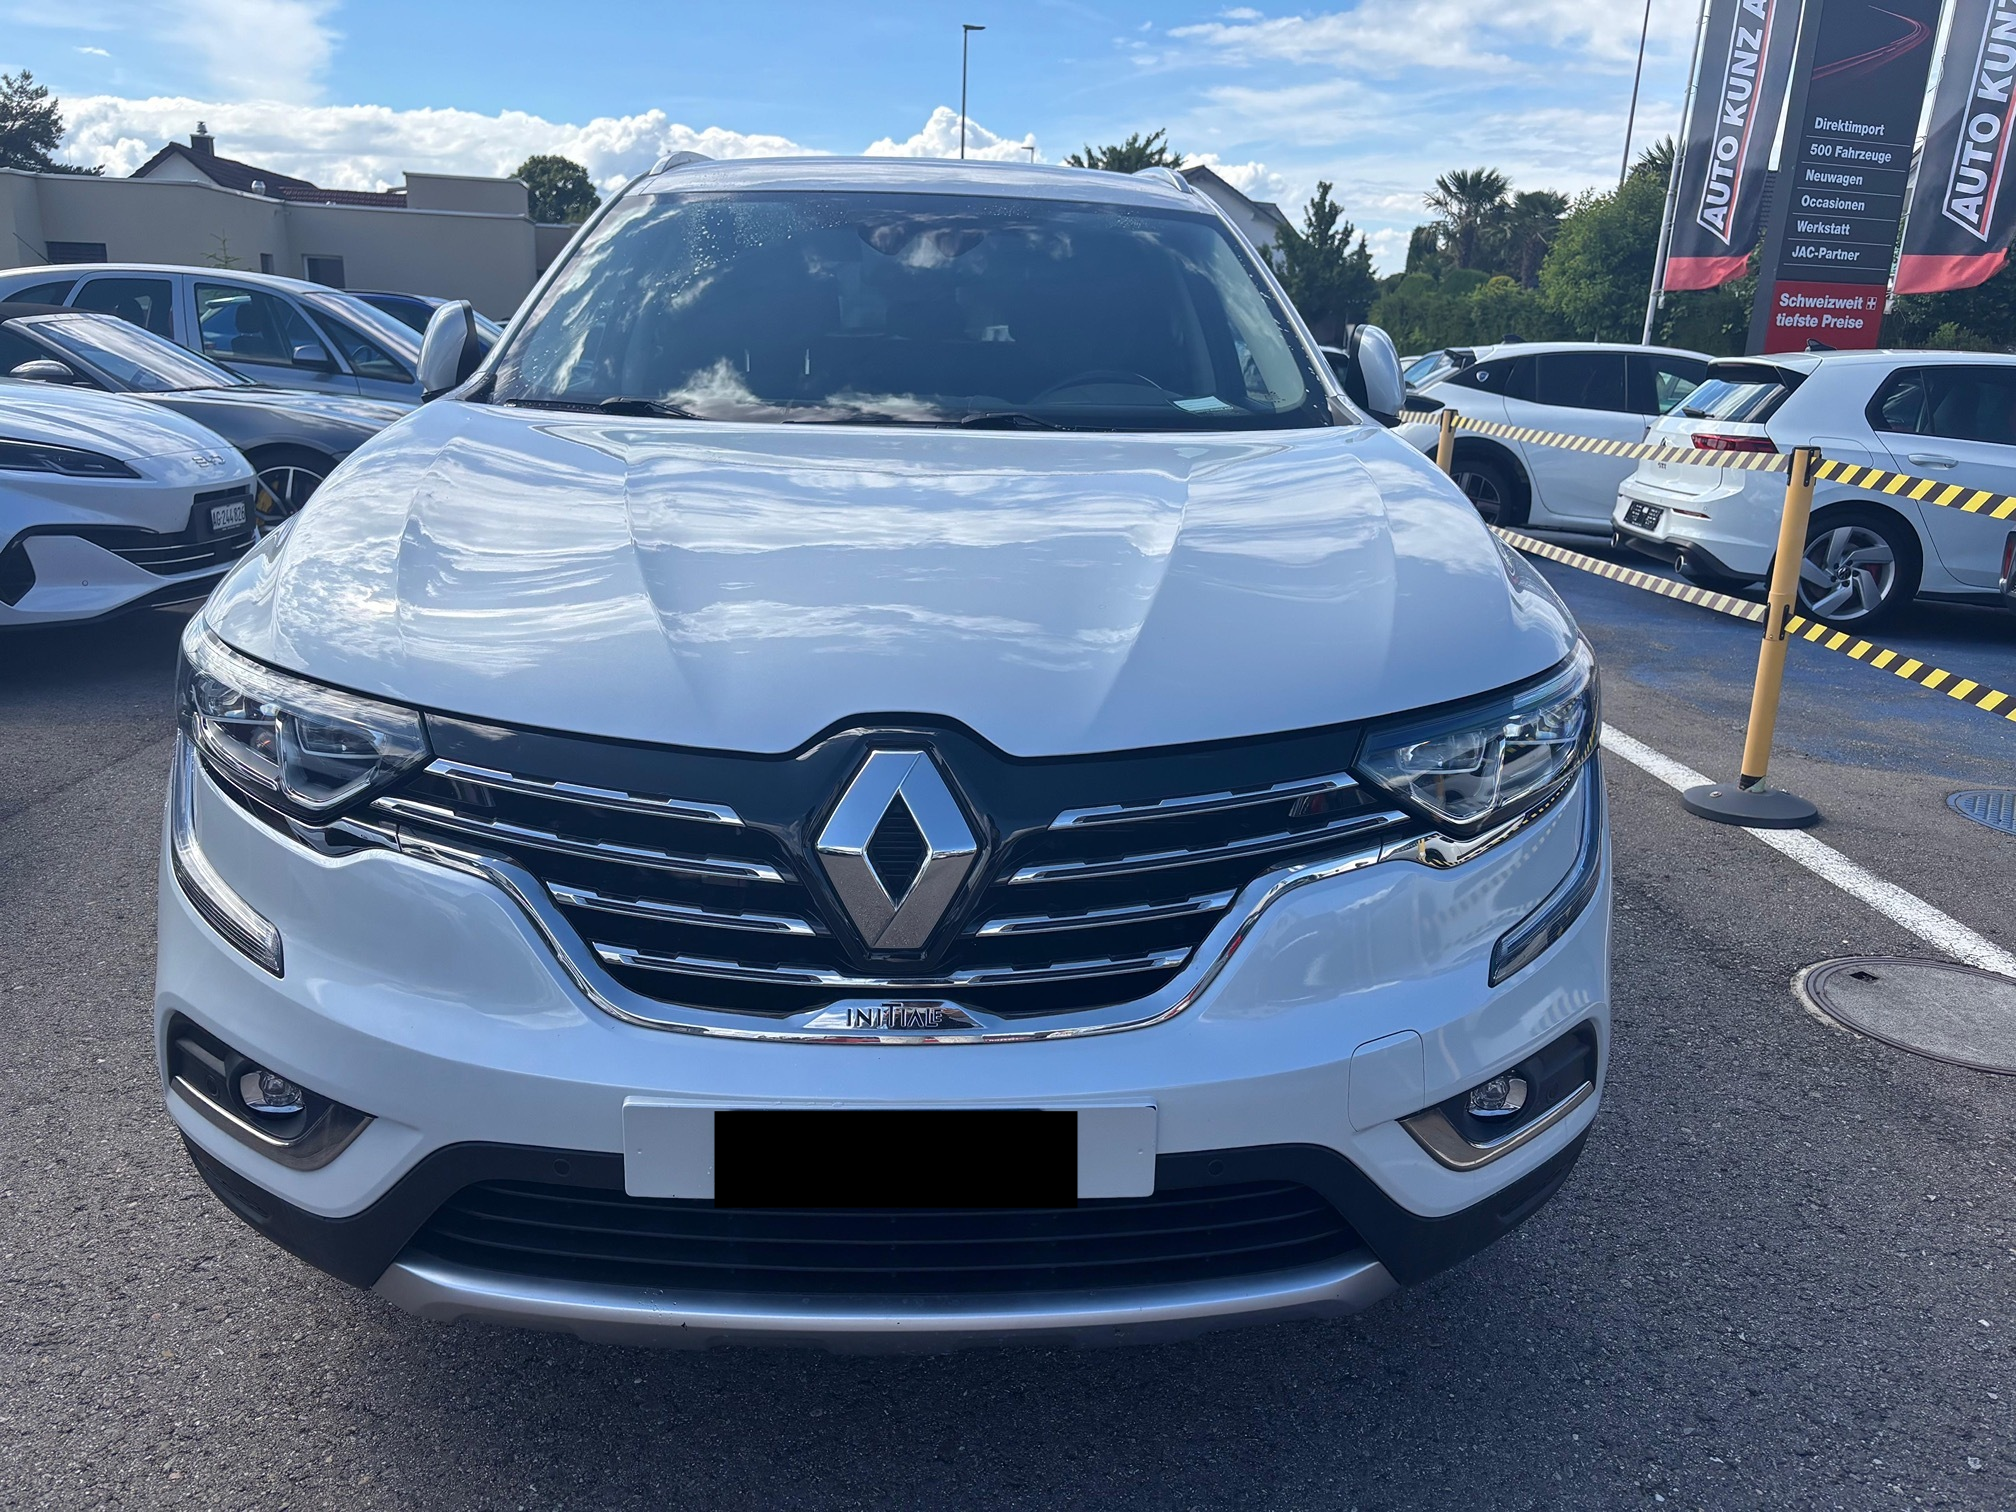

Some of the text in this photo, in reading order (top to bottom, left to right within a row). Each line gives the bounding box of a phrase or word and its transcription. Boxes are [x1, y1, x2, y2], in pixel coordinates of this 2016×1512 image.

[1950, 0, 2016, 225] AUTO KUN
[1703, 135, 1739, 231] AUTO
[1722, 26, 1763, 127] KUNZ
[1814, 116, 1885, 137] Direktimport
[1809, 143, 1892, 164] 500 Fahrzeuge
[1805, 168, 1863, 187] Neuwagen
[1801, 194, 1865, 211] Occasionen
[1797, 220, 1851, 235] Werkstatt
[1791, 245, 1860, 261] JAC-Partner
[1779, 292, 1864, 310] Schweizweit
[1776, 312, 1864, 329] tiefste Preise
[846, 1002, 943, 1028] INITIALE
